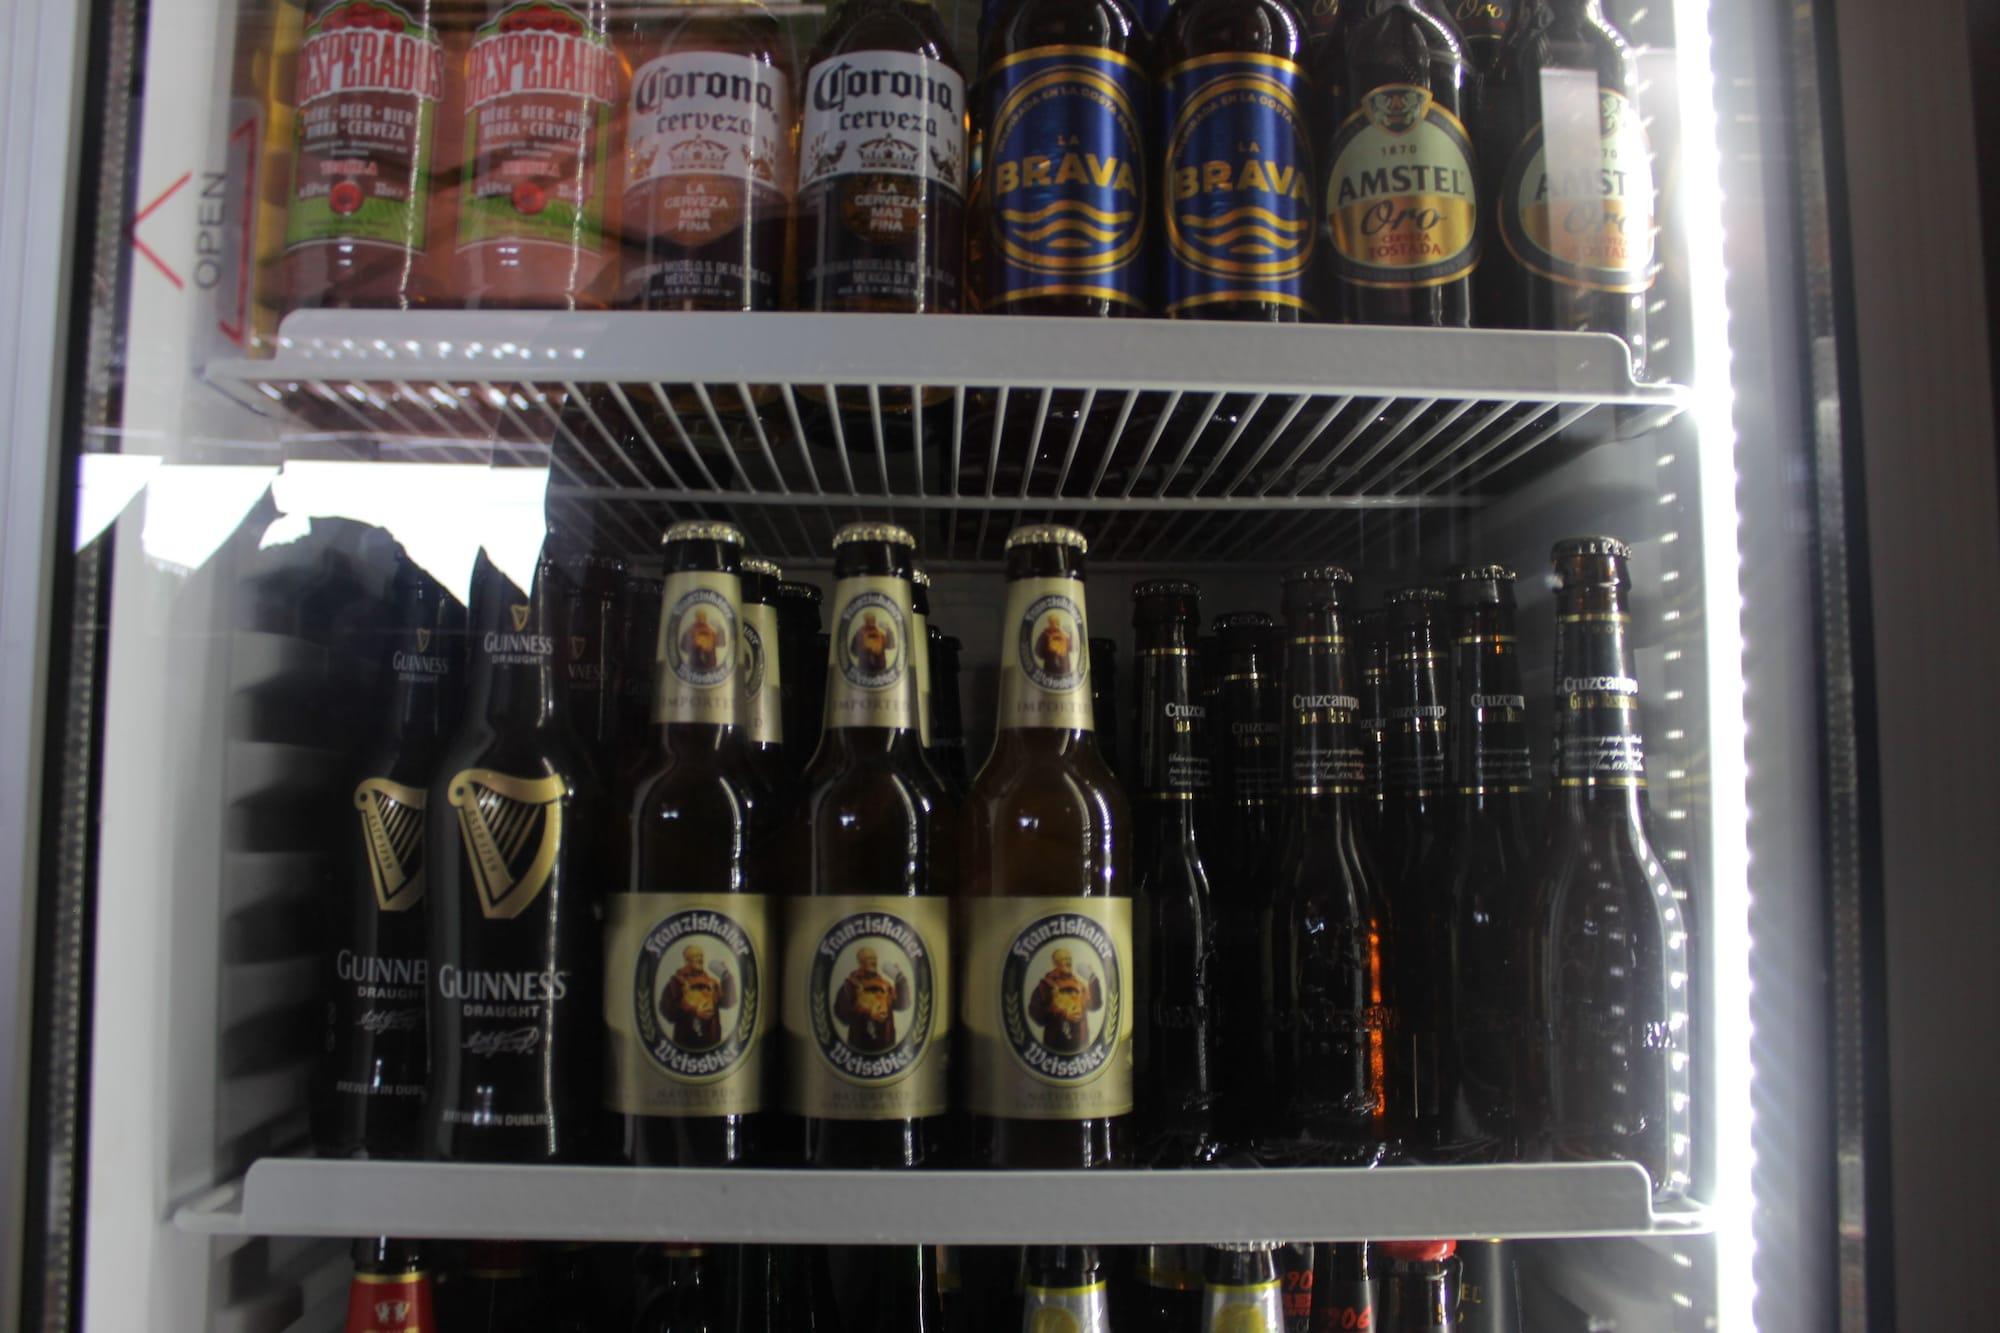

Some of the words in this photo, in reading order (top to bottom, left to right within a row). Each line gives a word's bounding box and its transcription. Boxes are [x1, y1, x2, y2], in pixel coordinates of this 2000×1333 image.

[636, 66, 773, 114] Corona
[814, 63, 953, 112] Corona
[347, 120, 405, 140] CERVEZA
[840, 111, 936, 136] cerveza
[1382, 144, 1417, 155] 1870
[996, 153, 1136, 196] BRAVA
[1175, 160, 1309, 206] BRAVA
[1338, 165, 1466, 206] AMSTEL
[193, 172, 226, 289] OPEN
[1361, 200, 1447, 236] Oro
[1370, 244, 1441, 259] TOSTADA
[484, 632, 553, 655] GUINNESS
[393, 651, 448, 673] GUINNESS
[646, 912, 749, 957] Franziskaner
[821, 915, 923, 960] Franziskaner
[1014, 916, 1112, 961] Franziskaner
[337, 949, 428, 985] GUINNE
[439, 964, 567, 1000] GUINNESS
[463, 1004, 541, 1018] DRAUGHT
[654, 1040, 739, 1074] Weissbier
[830, 1042, 914, 1077] Weissbier
[1024, 1043, 1106, 1077] Weissbier
